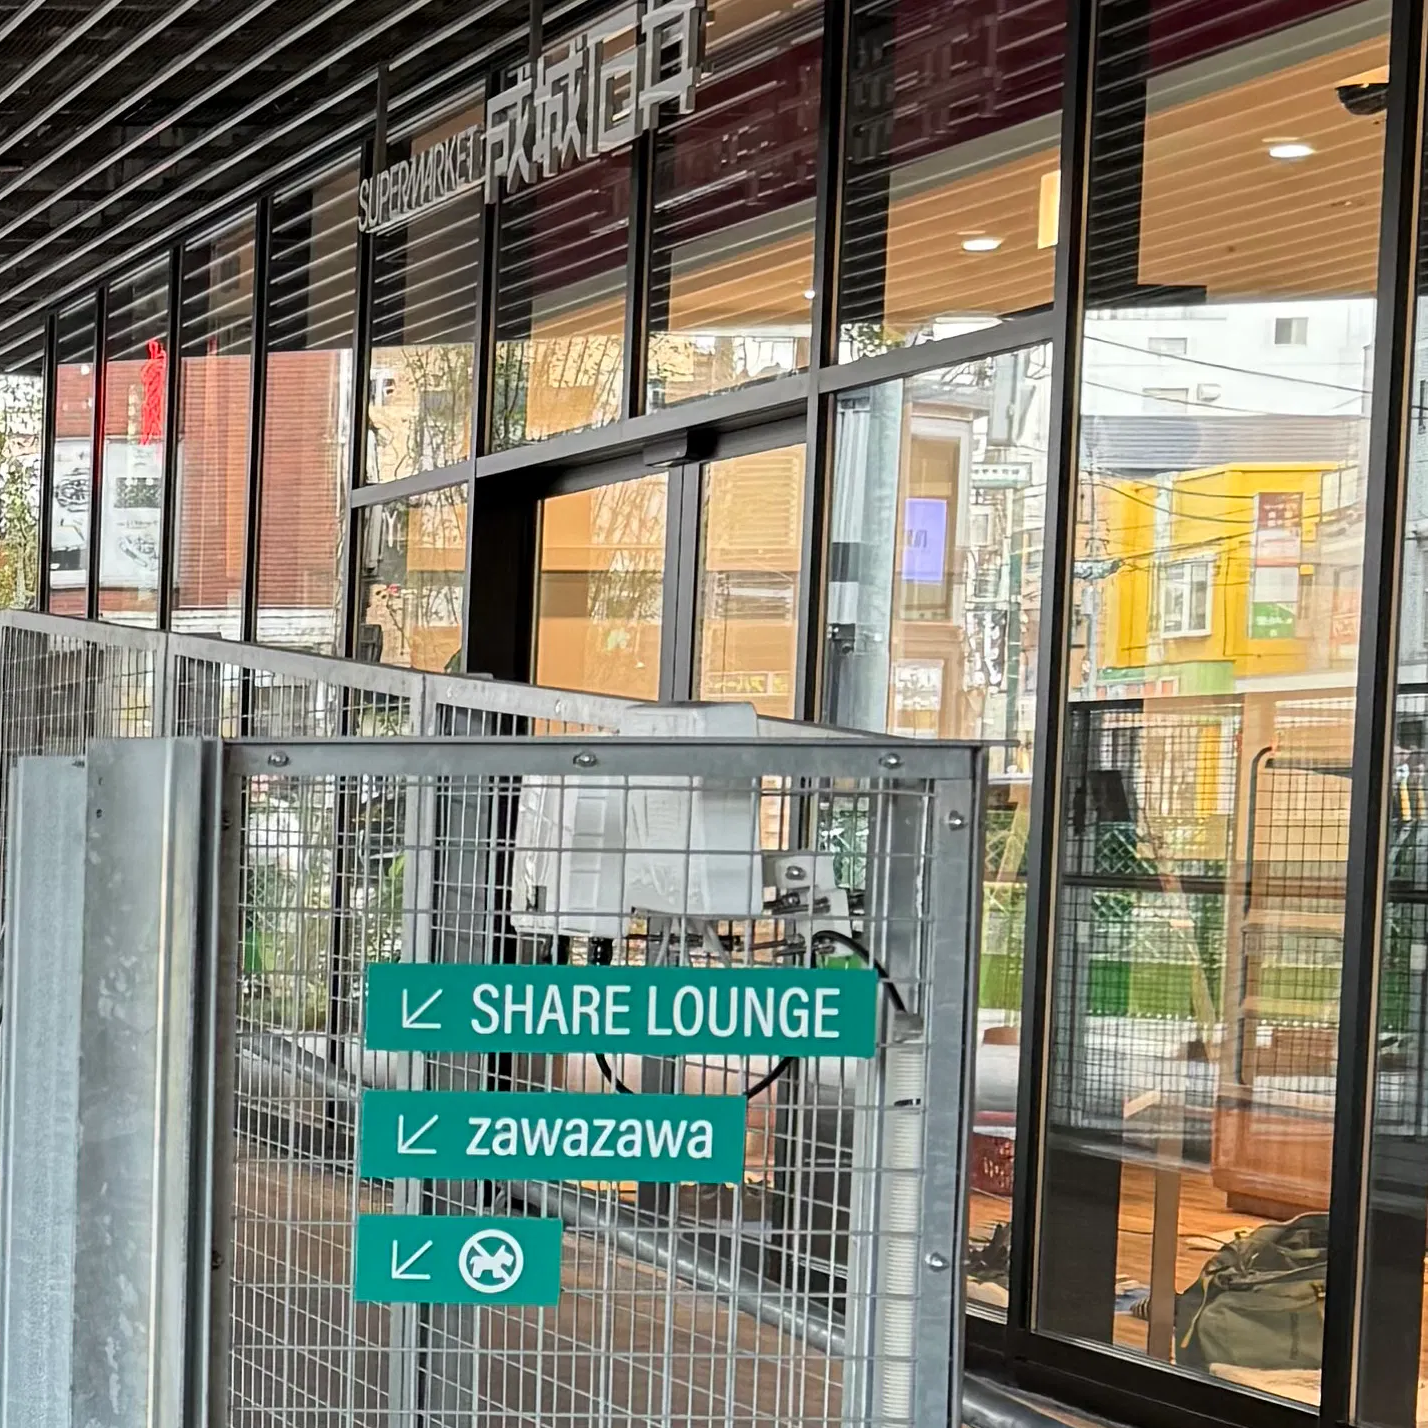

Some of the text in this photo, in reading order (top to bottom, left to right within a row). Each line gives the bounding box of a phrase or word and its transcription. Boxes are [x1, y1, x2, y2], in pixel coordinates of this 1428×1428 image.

[358, 124, 486, 232] SUPERMARKET
[470, 983, 841, 1039] SHARE LOUNGE
[465, 1115, 714, 1159] zawazawa
